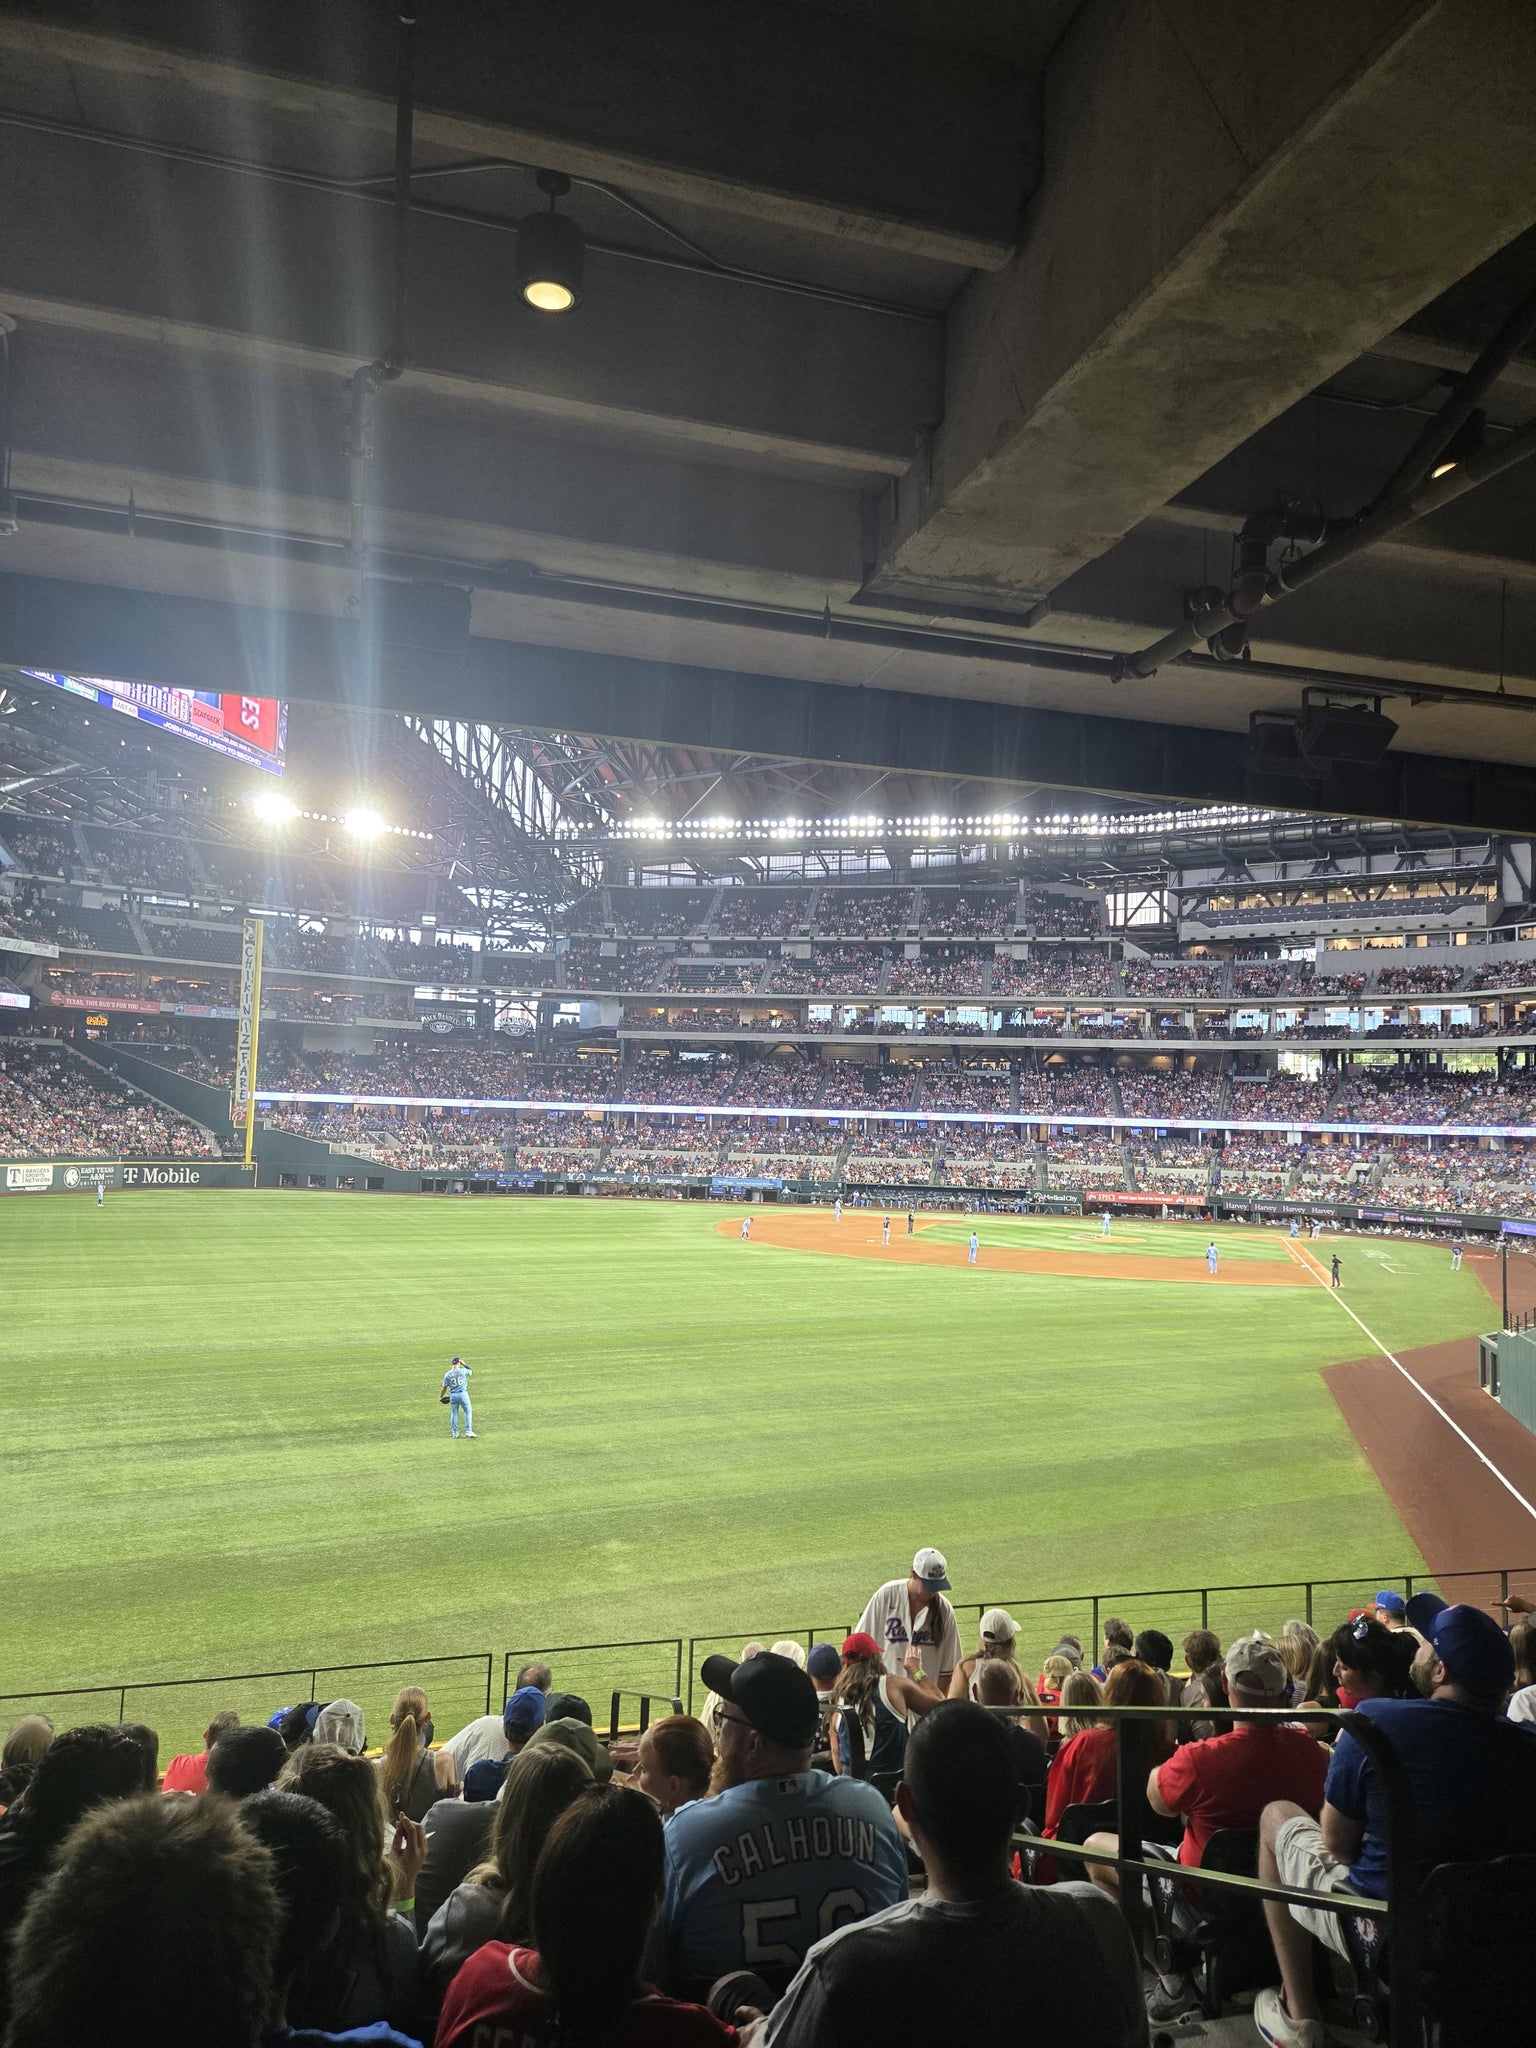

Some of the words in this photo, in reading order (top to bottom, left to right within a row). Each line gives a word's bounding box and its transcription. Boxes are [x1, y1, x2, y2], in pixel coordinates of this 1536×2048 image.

[193, 708, 221, 726] SEATGEEK
[163, 721, 183, 733] JOSH
[182, 728, 209, 745] NAYLOR
[209, 739, 227, 752] LINED
[227, 746, 237, 756] TO
[236, 750, 262, 766] SECOND
[243, 946, 254, 1016] CHIKIN
[241, 1022, 250, 1045] IZ
[239, 1052, 248, 1101] FARE
[96, 1166, 115, 1174] TEXAS
[142, 1167, 200, 1184] Mobile
[89, 1173, 105, 1181] A&M
[592, 1174, 618, 1182] American
[656, 1177, 682, 1185] American
[1065, 1195, 1078, 1203] City
[1098, 1193, 1116, 1201] SPEC'S
[1186, 1196, 1204, 1204] SPEC'S
[1225, 1202, 1248, 1211] Harvey
[1254, 1203, 1277, 1212] Harvey
[1282, 1205, 1306, 1215] Harvey
[1311, 1207, 1336, 1216] Harvey
[450, 1376, 464, 1387] 36
[713, 1816, 875, 1886] CALHOUN
